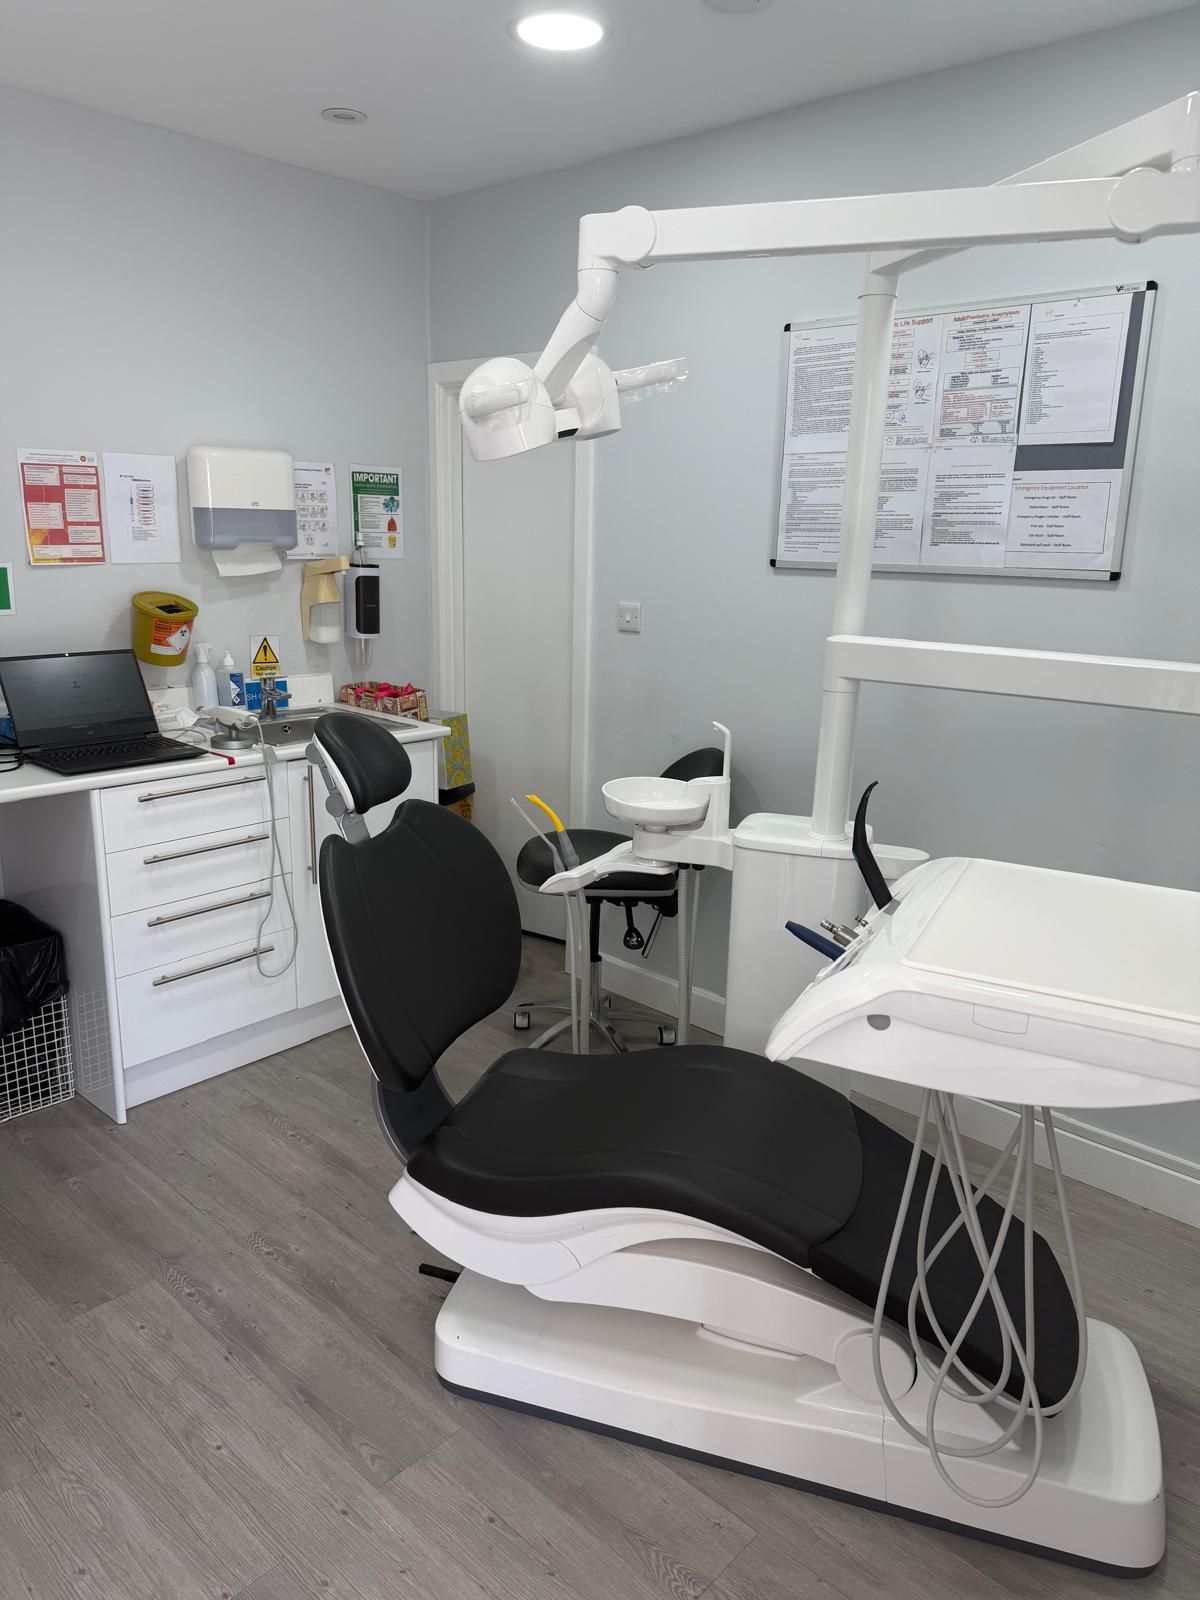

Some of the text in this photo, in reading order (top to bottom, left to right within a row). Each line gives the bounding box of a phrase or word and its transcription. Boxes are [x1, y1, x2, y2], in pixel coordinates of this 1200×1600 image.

[991, 310, 1020, 318] Anaphylaxis
[912, 318, 933, 326] Support
[354, 473, 398, 484] IMPORTANT
